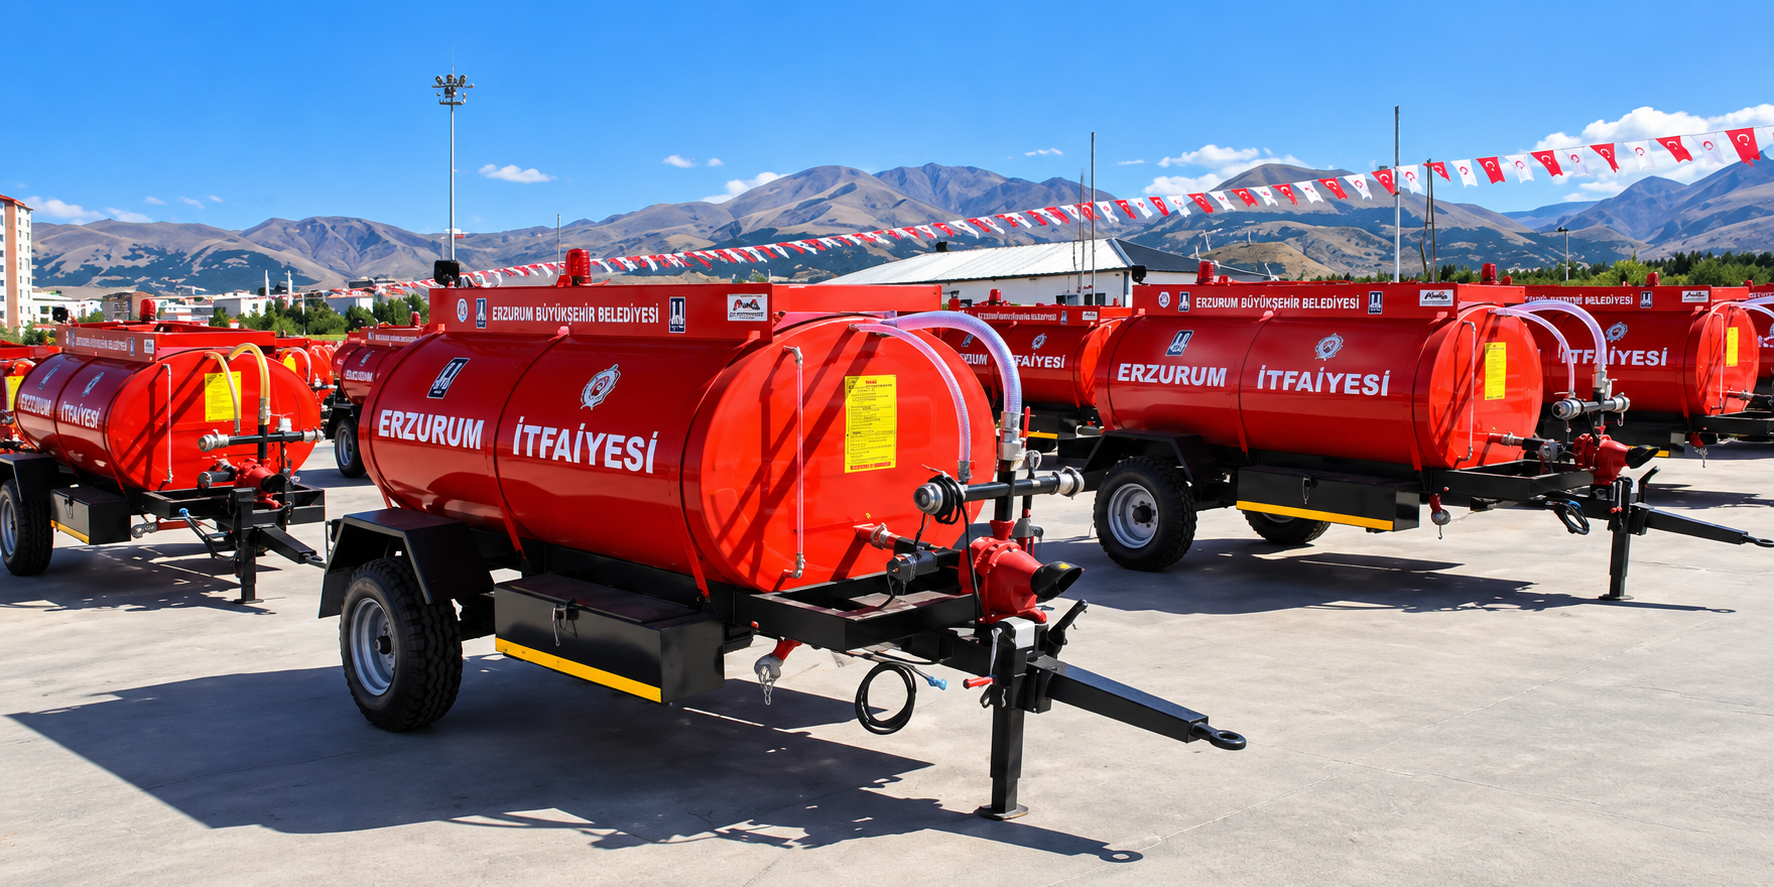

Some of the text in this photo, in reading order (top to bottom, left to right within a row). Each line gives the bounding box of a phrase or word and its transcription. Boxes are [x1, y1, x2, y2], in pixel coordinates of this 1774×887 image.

[1196, 297, 1238, 309] ERZURUM
[1302, 295, 1360, 309] BELEDİYESİ
[492, 306, 533, 321] ERZURUM
[598, 303, 659, 323] BELEDİYESİ
[1013, 353, 1066, 368] FAİYESİ
[1561, 346, 1668, 366] İTFİYESİ
[1117, 363, 1391, 396] ERZURUM İTFAİYESİ
[378, 409, 659, 474] ERZURUM İTFAİYESİ
